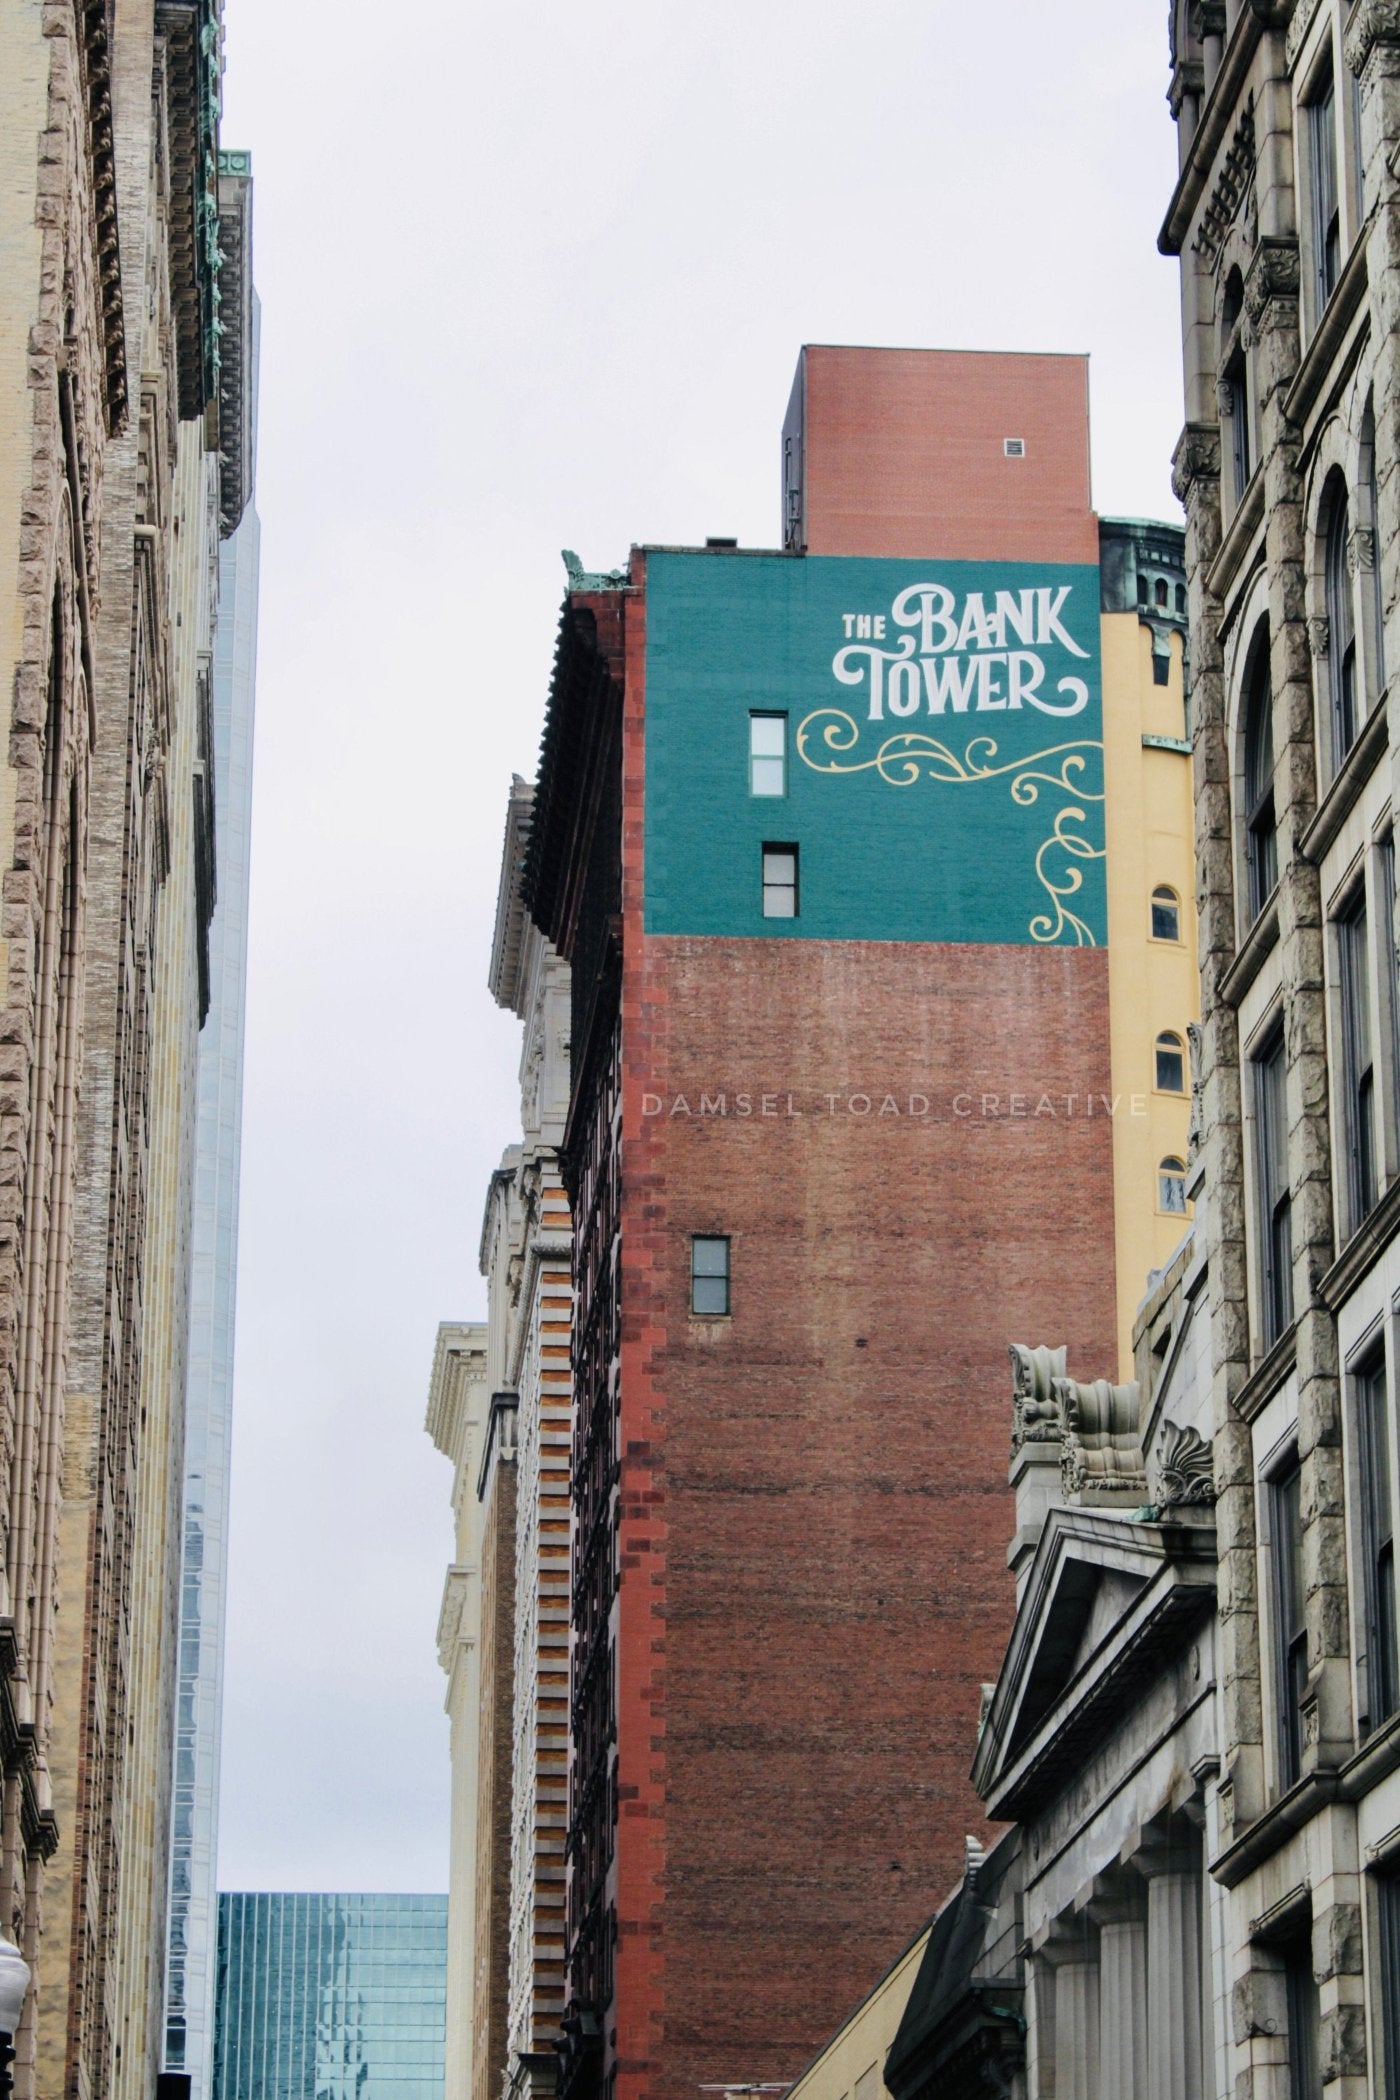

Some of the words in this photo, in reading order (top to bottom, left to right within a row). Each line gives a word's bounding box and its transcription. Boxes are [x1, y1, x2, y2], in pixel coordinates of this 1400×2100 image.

[842, 614, 886, 639] THE
[891, 583, 1091, 658] BANK
[832, 634, 1089, 720] TOWER
